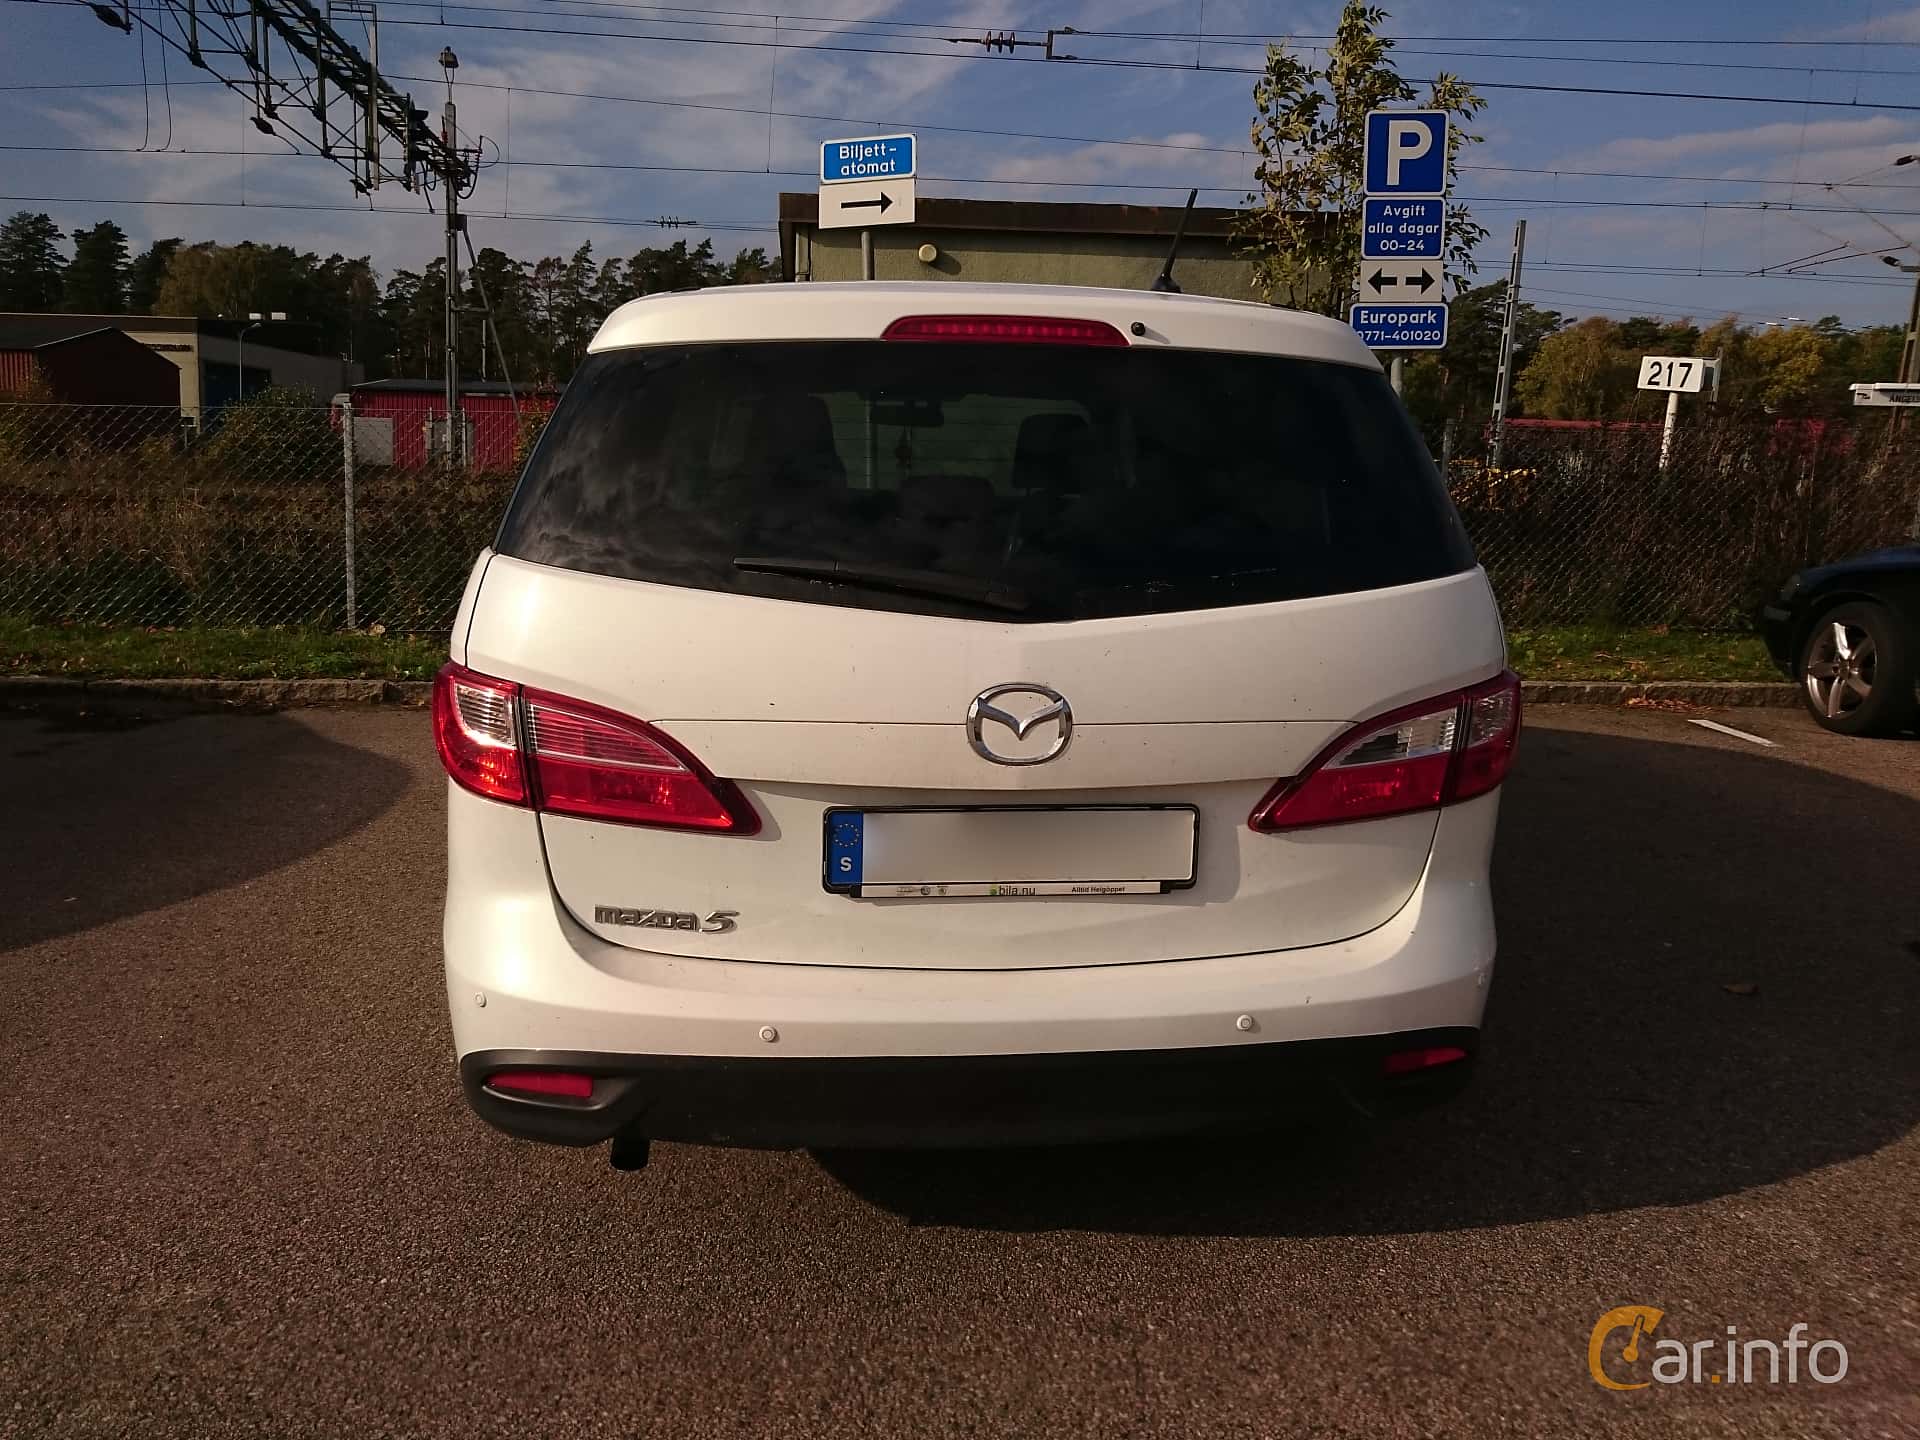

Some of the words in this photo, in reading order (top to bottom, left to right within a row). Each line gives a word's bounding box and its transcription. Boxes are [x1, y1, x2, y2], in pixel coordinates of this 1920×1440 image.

[839, 142, 897, 162] Biljett-
[1386, 119, 1433, 186] P
[841, 159, 896, 176] atomat
[1383, 204, 1425, 219] Avgift
[1368, 222, 1393, 234] alla
[1399, 222, 1440, 237] dagar
[1380, 239, 1425, 251] 00-24
[1360, 309, 1437, 327] Europark
[1647, 360, 1693, 388] 217
[839, 856, 852, 873] S
